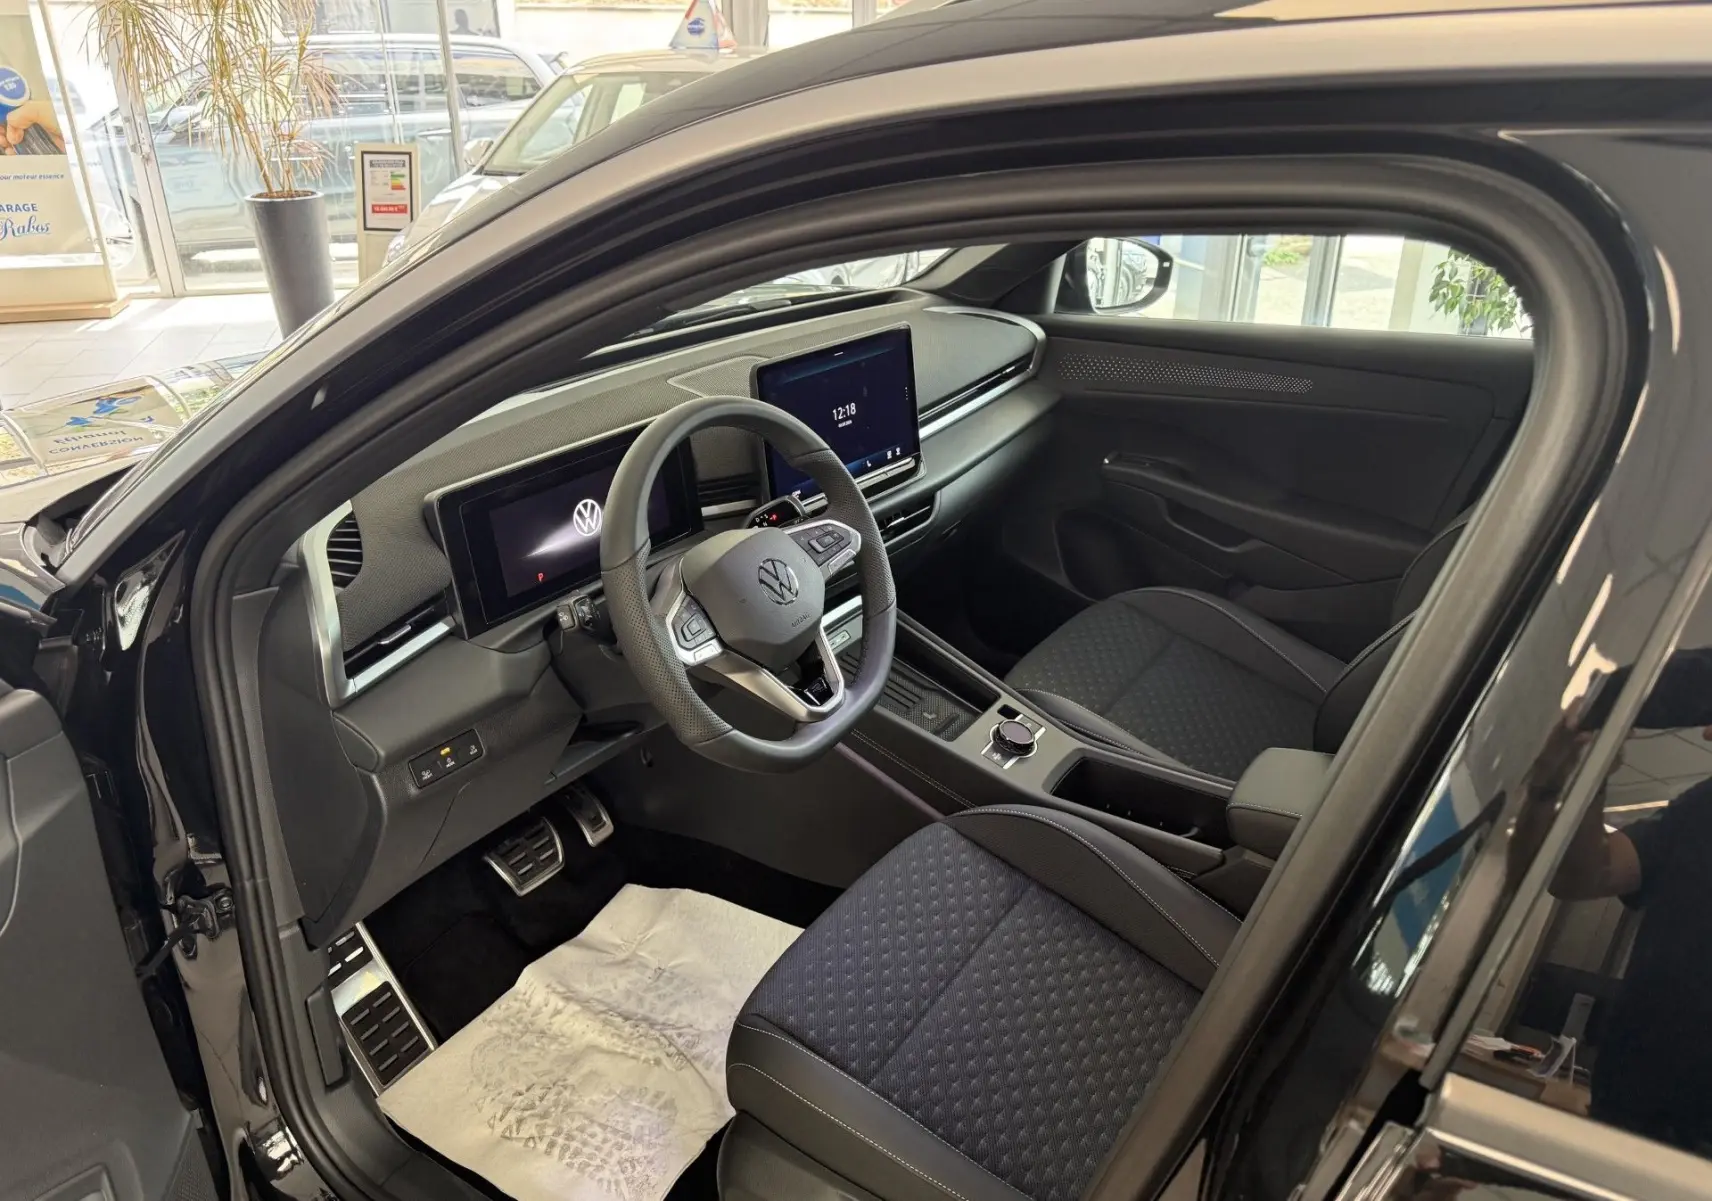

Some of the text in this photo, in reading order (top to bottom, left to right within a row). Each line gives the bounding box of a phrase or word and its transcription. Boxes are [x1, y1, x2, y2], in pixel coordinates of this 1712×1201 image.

[0, 203, 38, 213] ARAGE
[832, 402, 856, 421] 12:18
[537, 572, 544, 582] P
